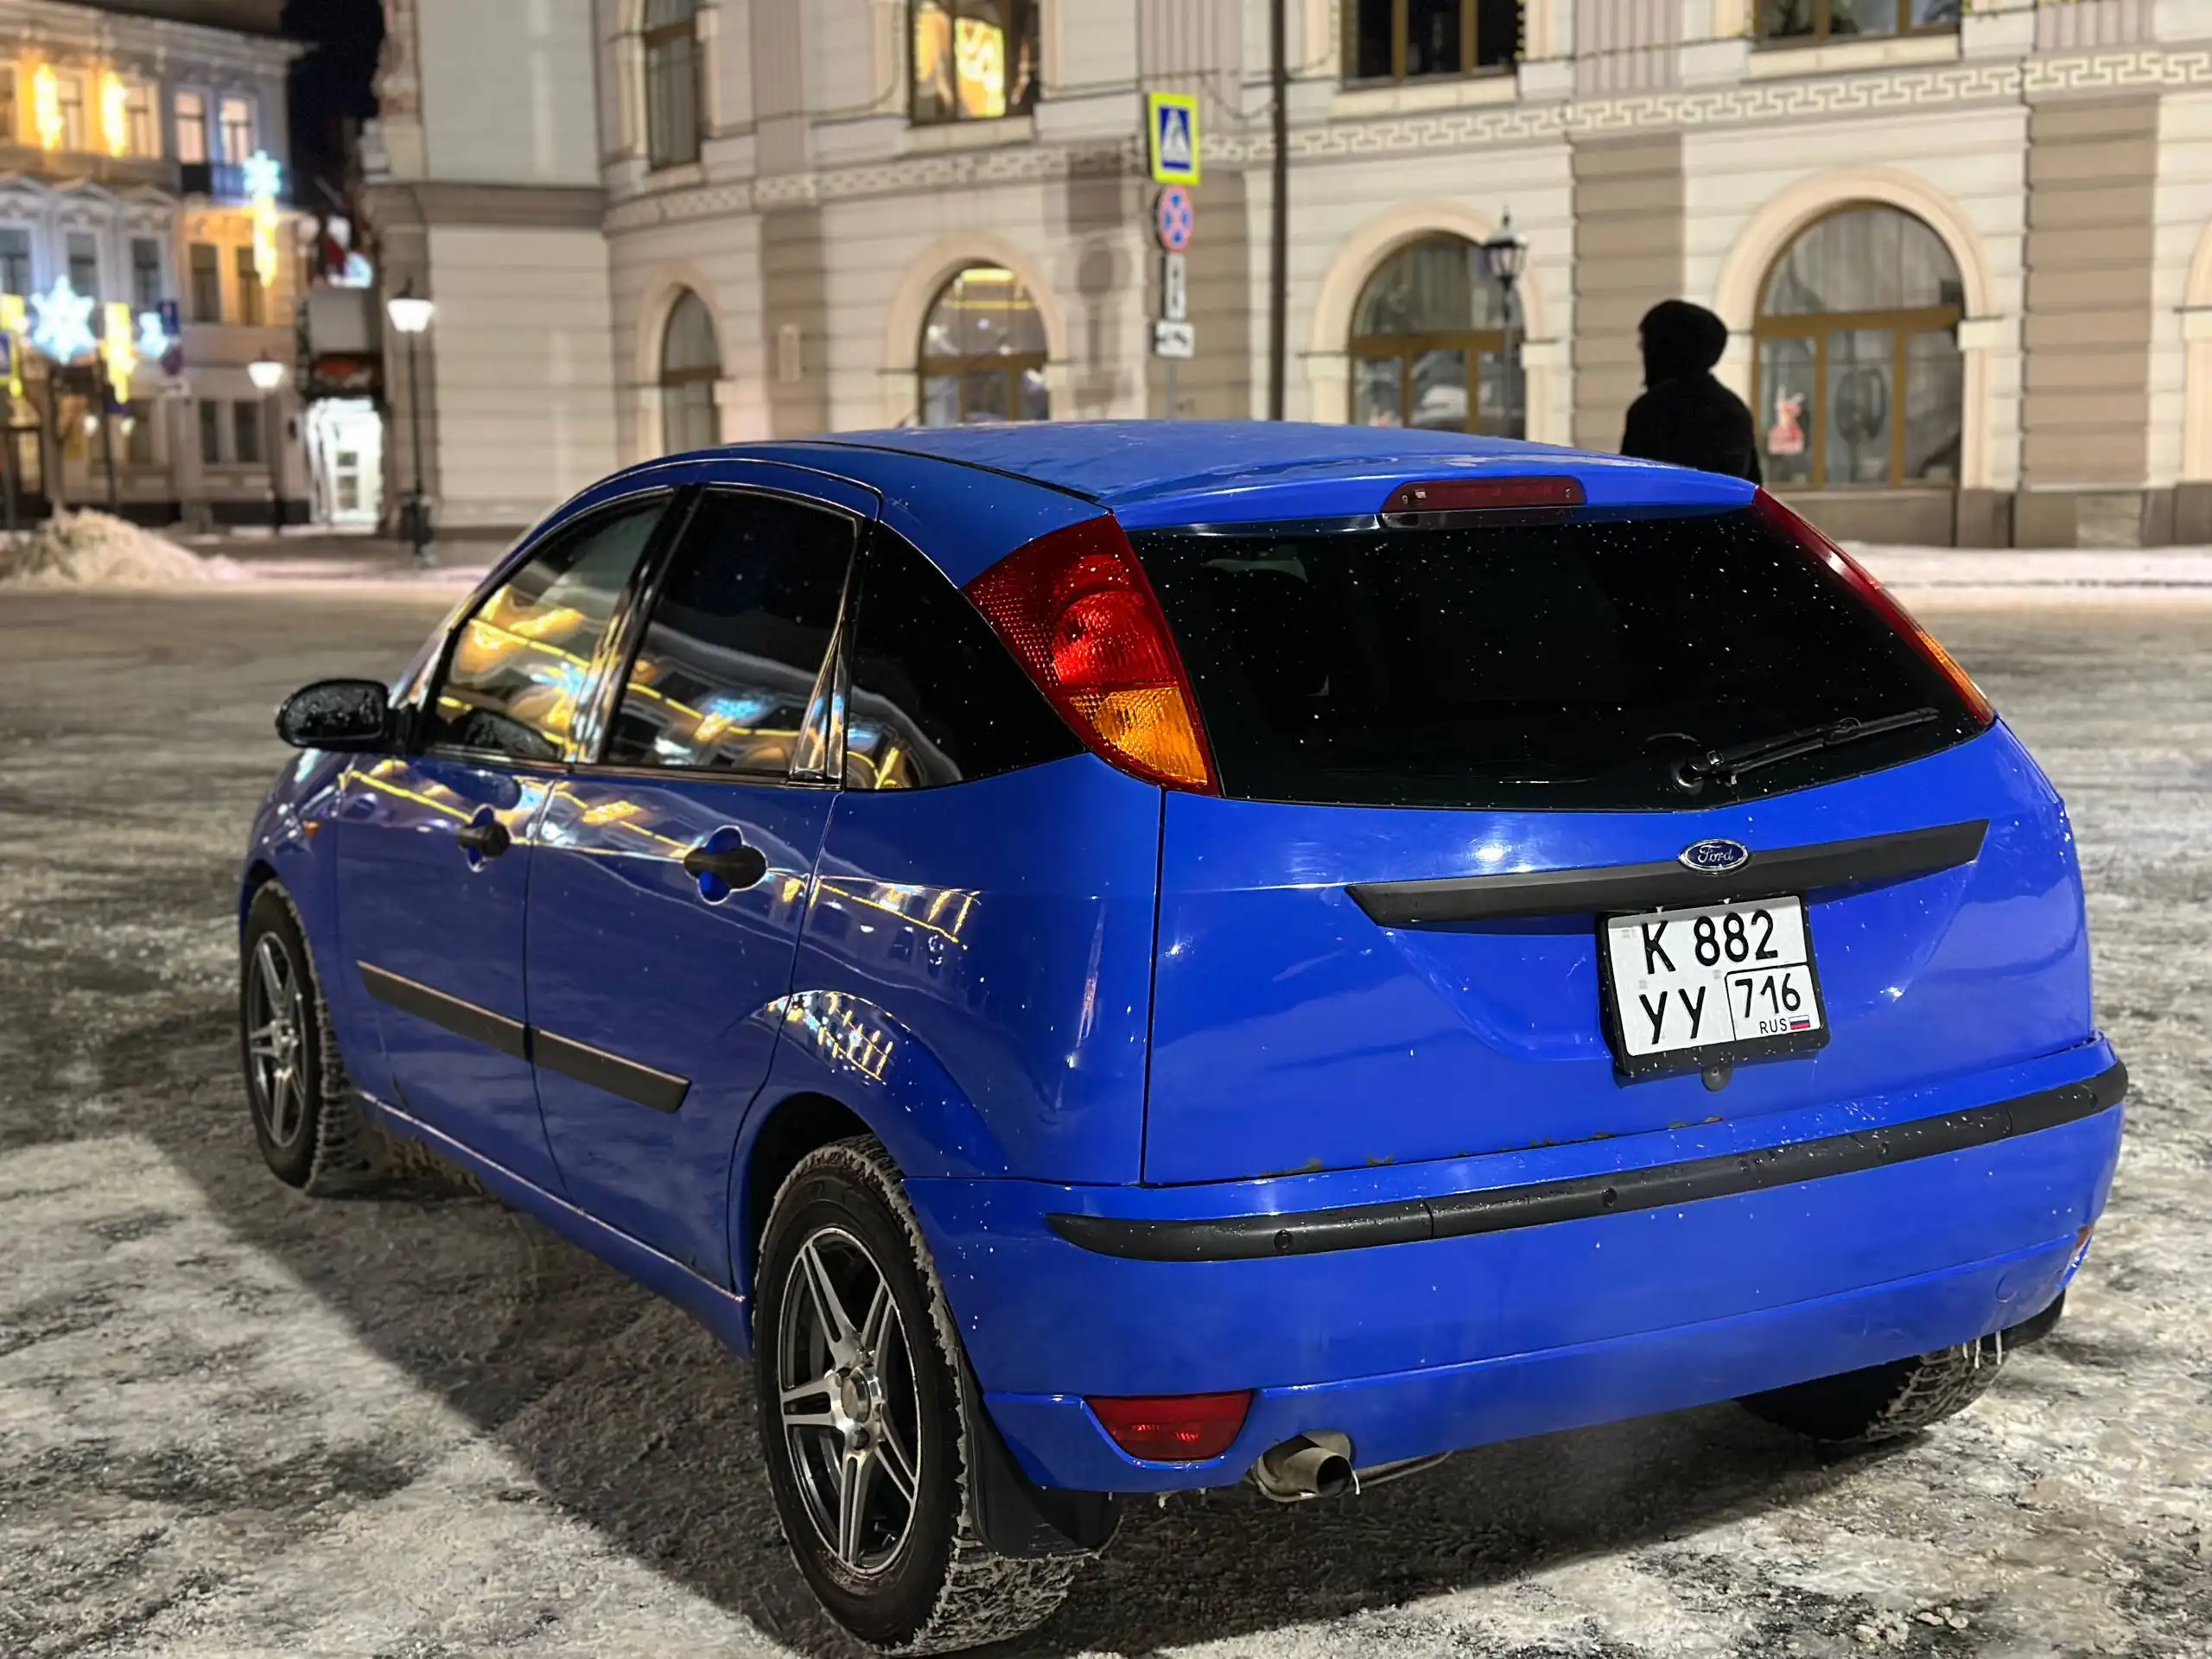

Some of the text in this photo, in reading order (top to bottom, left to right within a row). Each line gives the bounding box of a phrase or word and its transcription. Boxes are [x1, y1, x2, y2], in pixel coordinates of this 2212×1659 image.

[1696, 844, 1734, 863] Ford
[1694, 909, 1778, 967] 882
[1734, 973, 1802, 1019] 716
[1759, 1018, 1788, 1035] RUS
